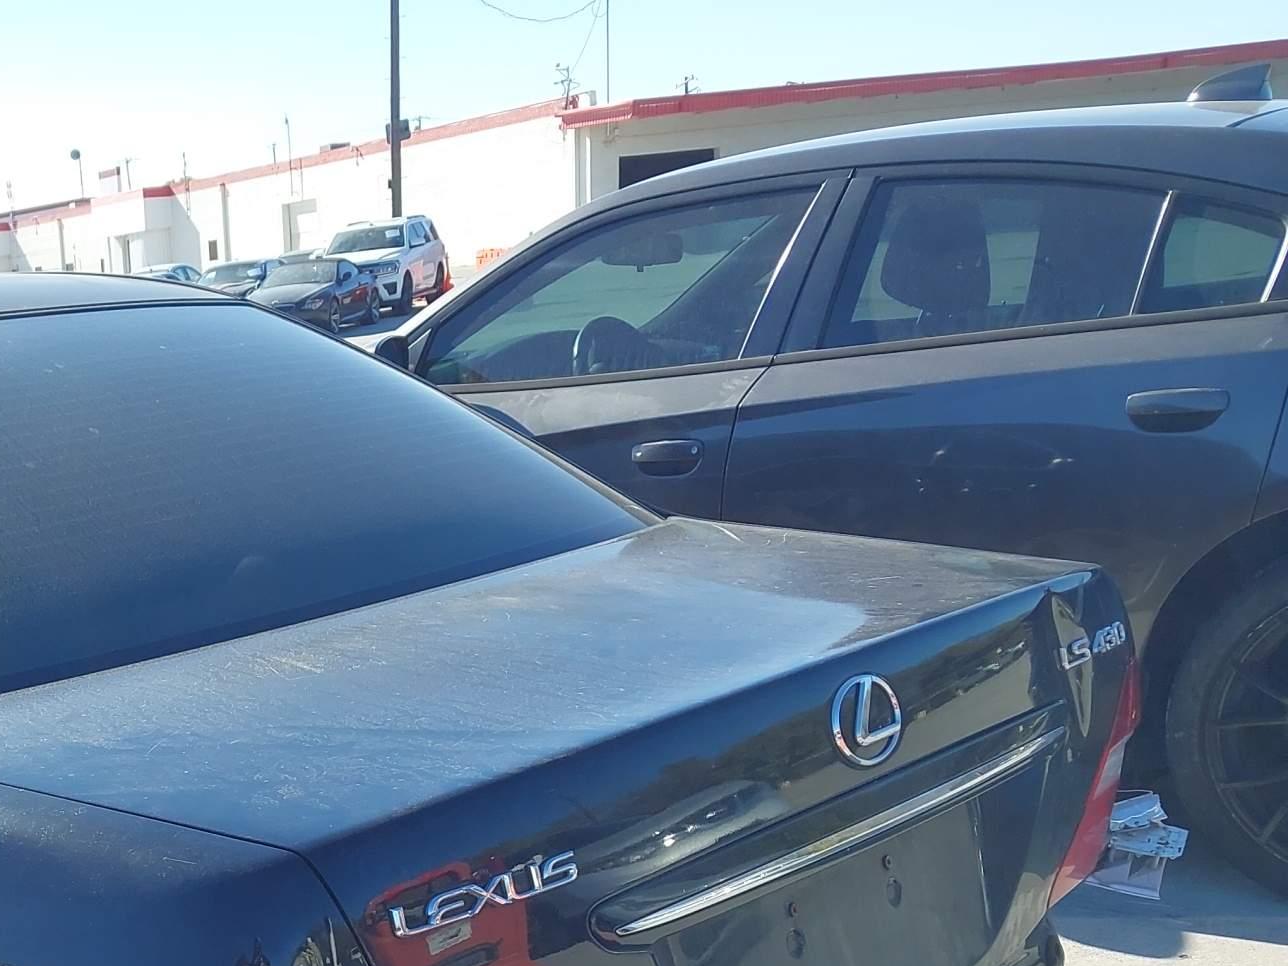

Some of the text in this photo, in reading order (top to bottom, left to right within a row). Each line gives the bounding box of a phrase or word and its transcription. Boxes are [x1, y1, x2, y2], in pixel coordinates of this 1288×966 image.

[1059, 621, 1127, 671] LS 430
[388, 850, 579, 938] LEXUS
